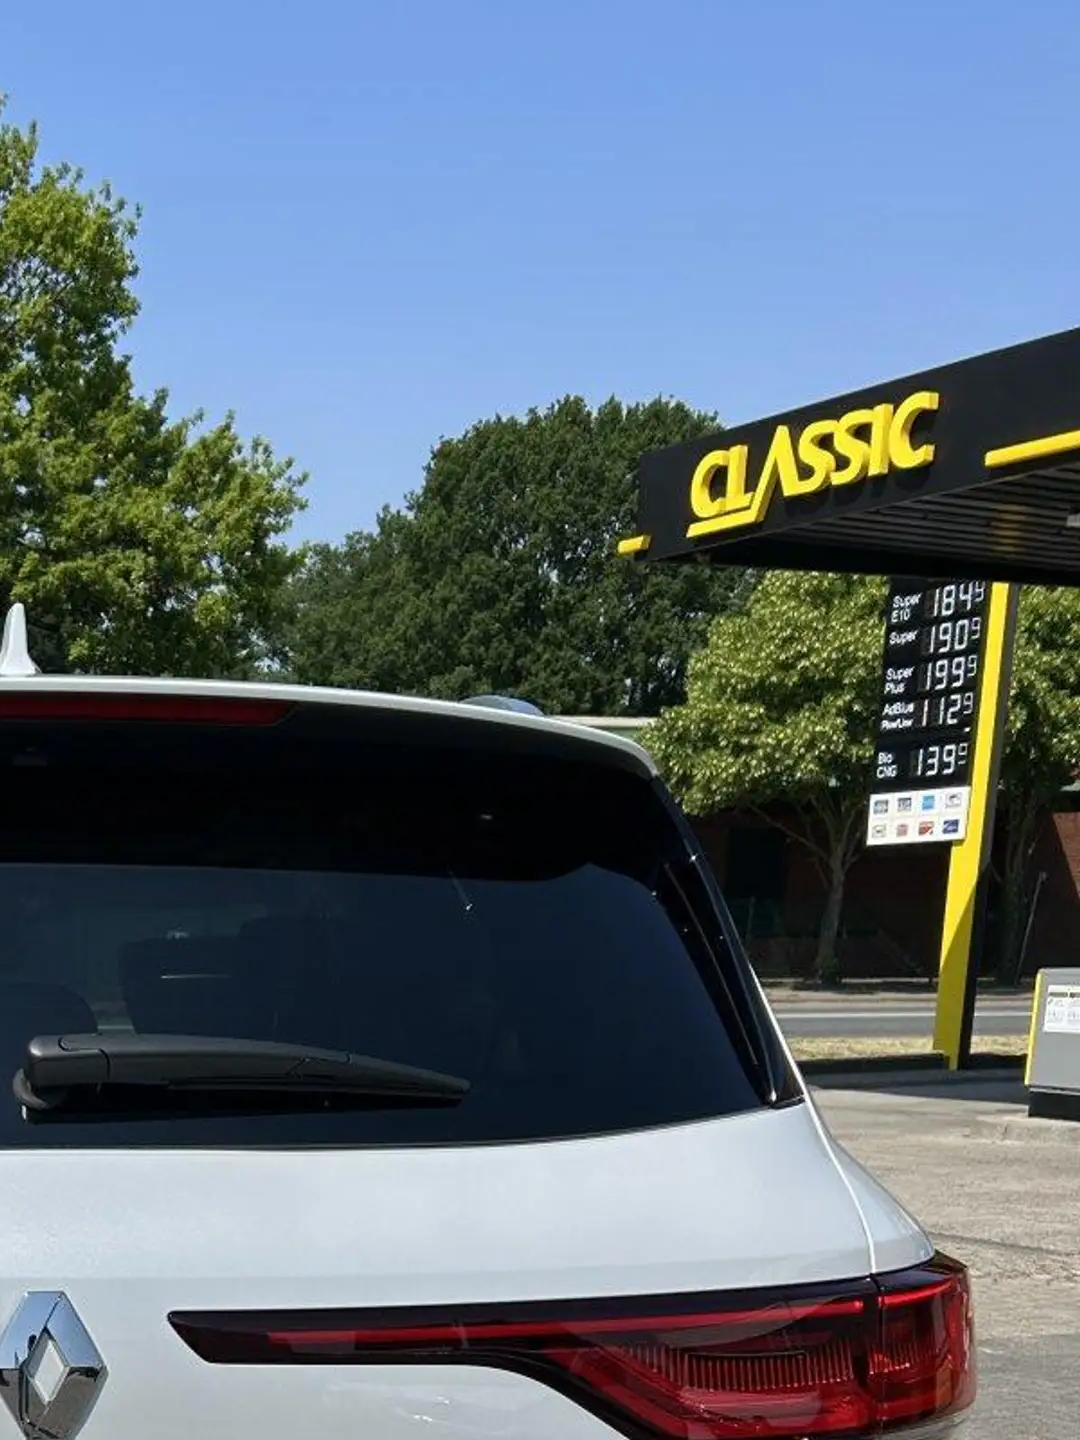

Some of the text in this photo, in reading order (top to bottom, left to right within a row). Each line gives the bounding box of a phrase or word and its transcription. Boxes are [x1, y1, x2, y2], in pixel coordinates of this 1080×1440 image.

[686, 391, 939, 537] CLASSIC
[892, 592, 922, 608] Super
[891, 608, 911, 623] E10
[888, 629, 918, 645] Super
[885, 666, 915, 681] Super
[884, 682, 906, 695] Plus
[882, 701, 915, 716] AdBlue
[876, 764, 898, 779] CNG
